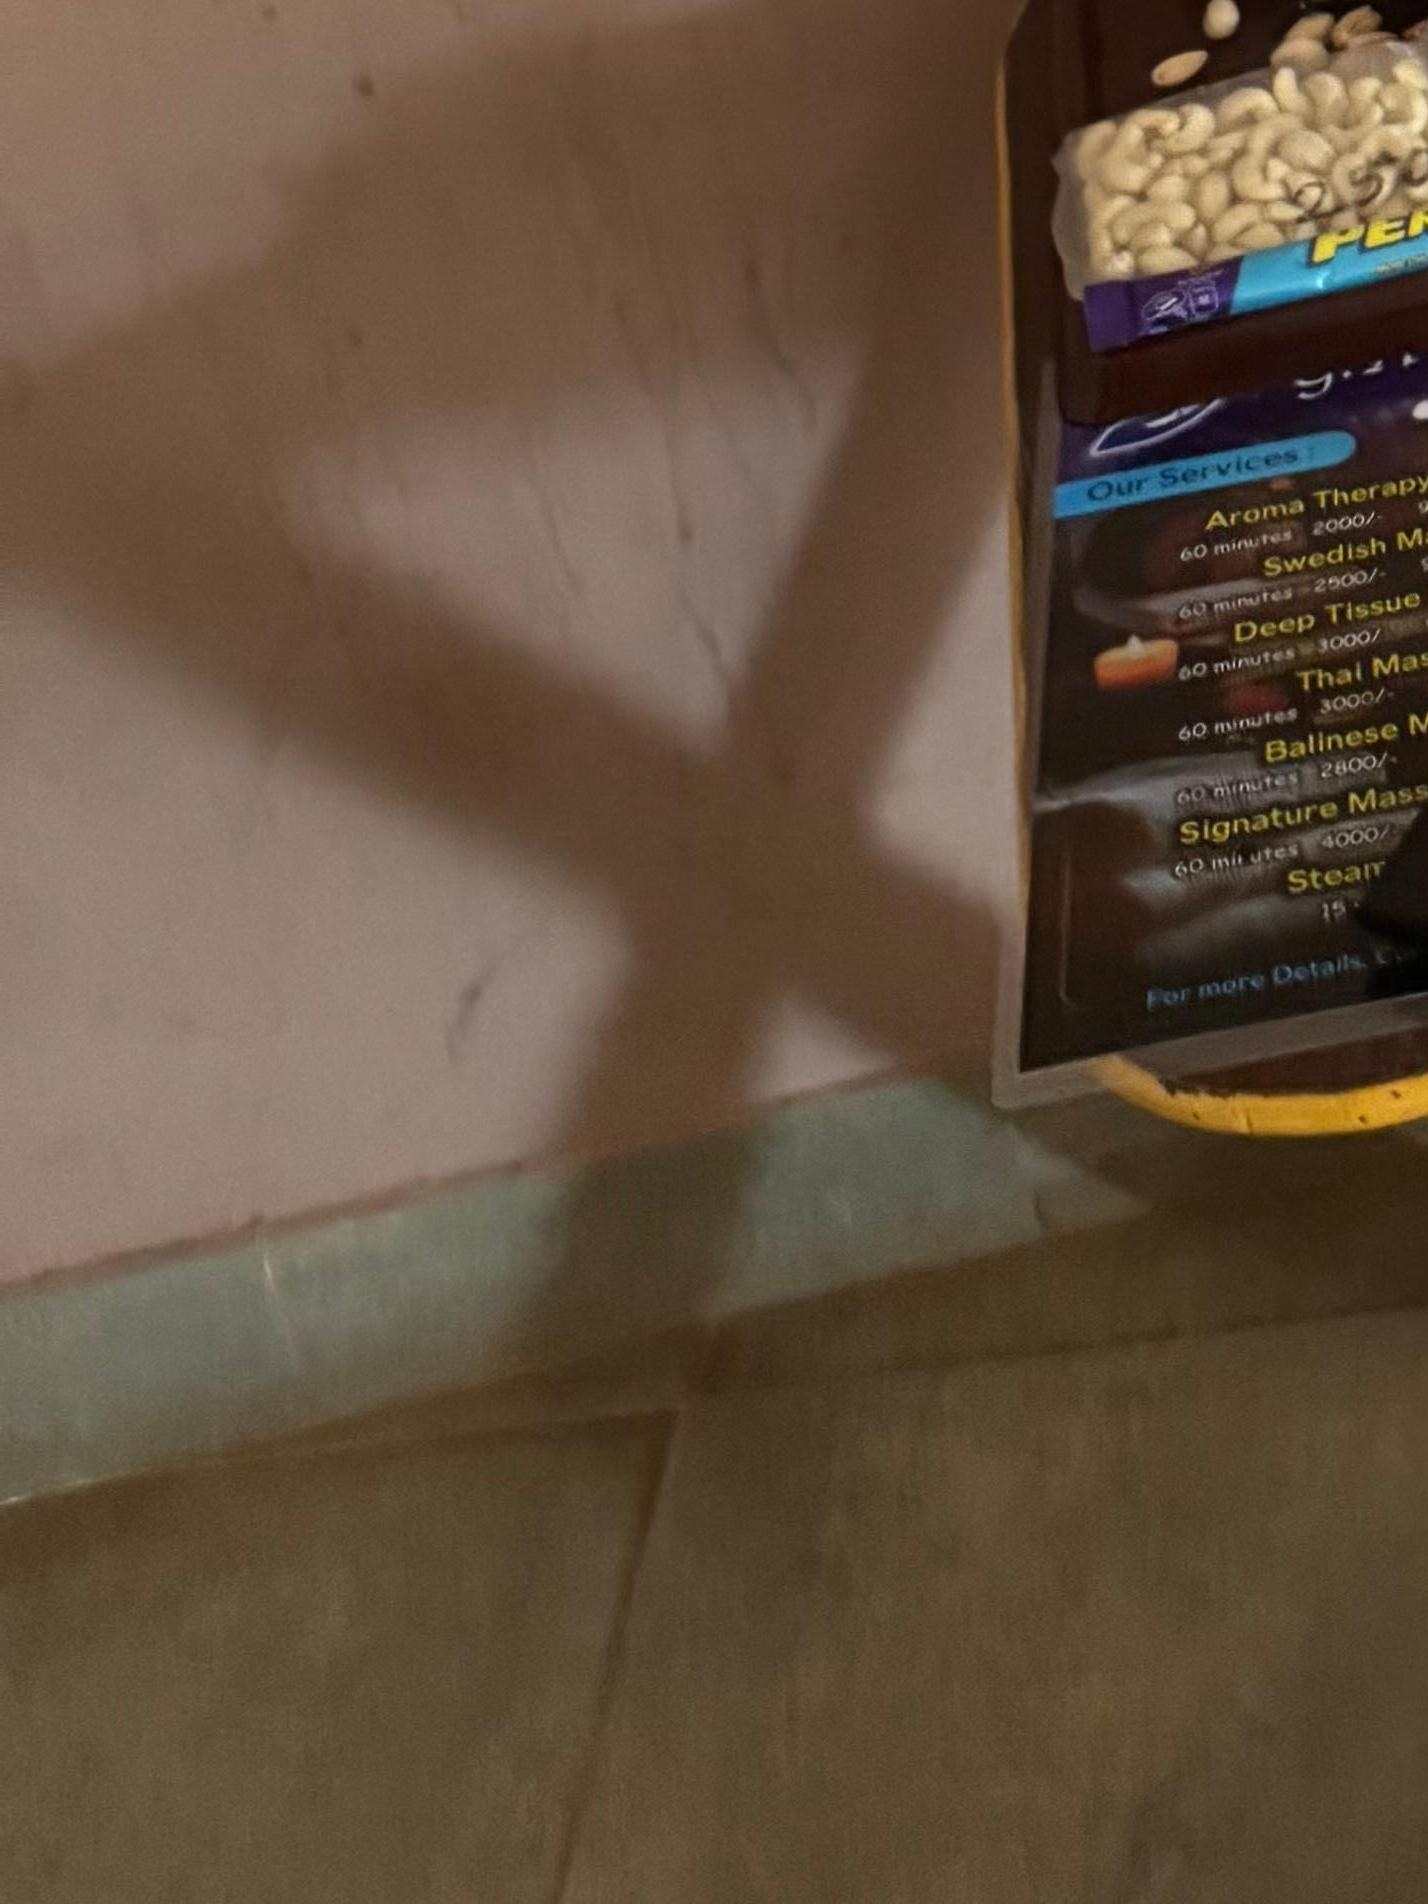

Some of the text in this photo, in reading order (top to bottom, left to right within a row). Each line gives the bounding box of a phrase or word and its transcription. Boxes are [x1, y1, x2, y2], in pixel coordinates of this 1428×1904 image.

[1086, 448, 1298, 503] Our Services
[1205, 498, 1305, 531] Aroma
[1179, 543, 1208, 563] 60
[1213, 530, 1293, 557] minutes
[1262, 538, 1386, 578] Swedish
[1178, 602, 1207, 620] 60
[1213, 587, 1293, 615] minutes
[1233, 613, 1316, 643] Deep
[1324, 592, 1422, 625] Tissue
[1178, 663, 1207, 682] 60
[1213, 648, 1297, 676] minutes
[1297, 661, 1363, 693] Thai
[1178, 722, 1207, 741] 60
[1213, 707, 1299, 735] minutes
[1263, 722, 1400, 764] Balinese
[1177, 787, 1206, 806] 60
[1213, 772, 1299, 800] minutes
[1179, 800, 1339, 845] Signature
[1174, 858, 1205, 879] 60
[1198, 973, 1265, 999] more
